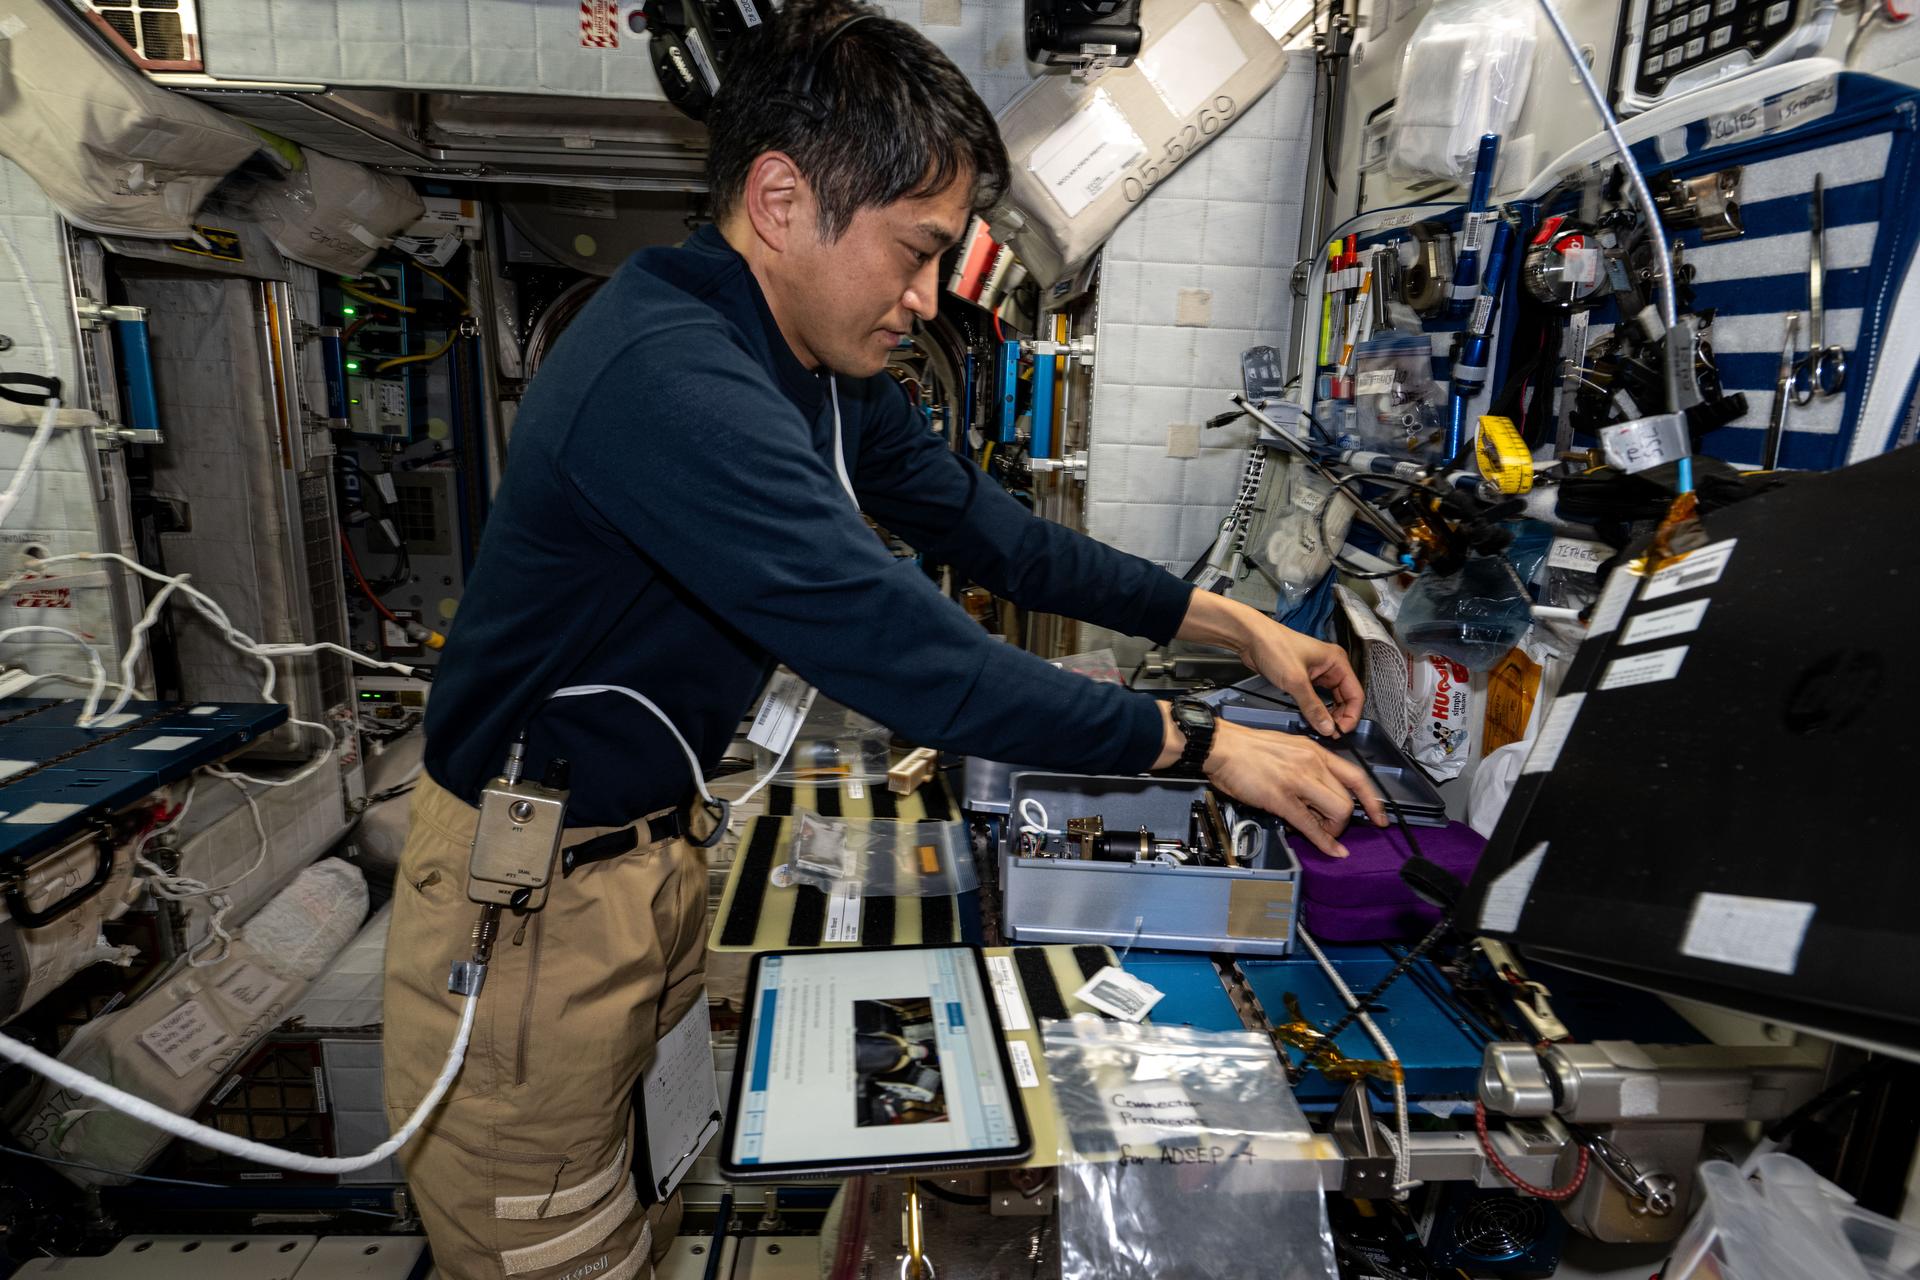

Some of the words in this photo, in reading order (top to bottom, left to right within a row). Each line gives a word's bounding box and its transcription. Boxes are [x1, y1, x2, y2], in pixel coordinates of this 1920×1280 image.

[1120, 95, 1238, 203] 05-5269
[1553, 542, 1602, 563] TETHERS
[1453, 691, 1463, 718] simply
[1111, 1093, 1203, 1109] Connector
[1118, 1143, 1149, 1167] for
